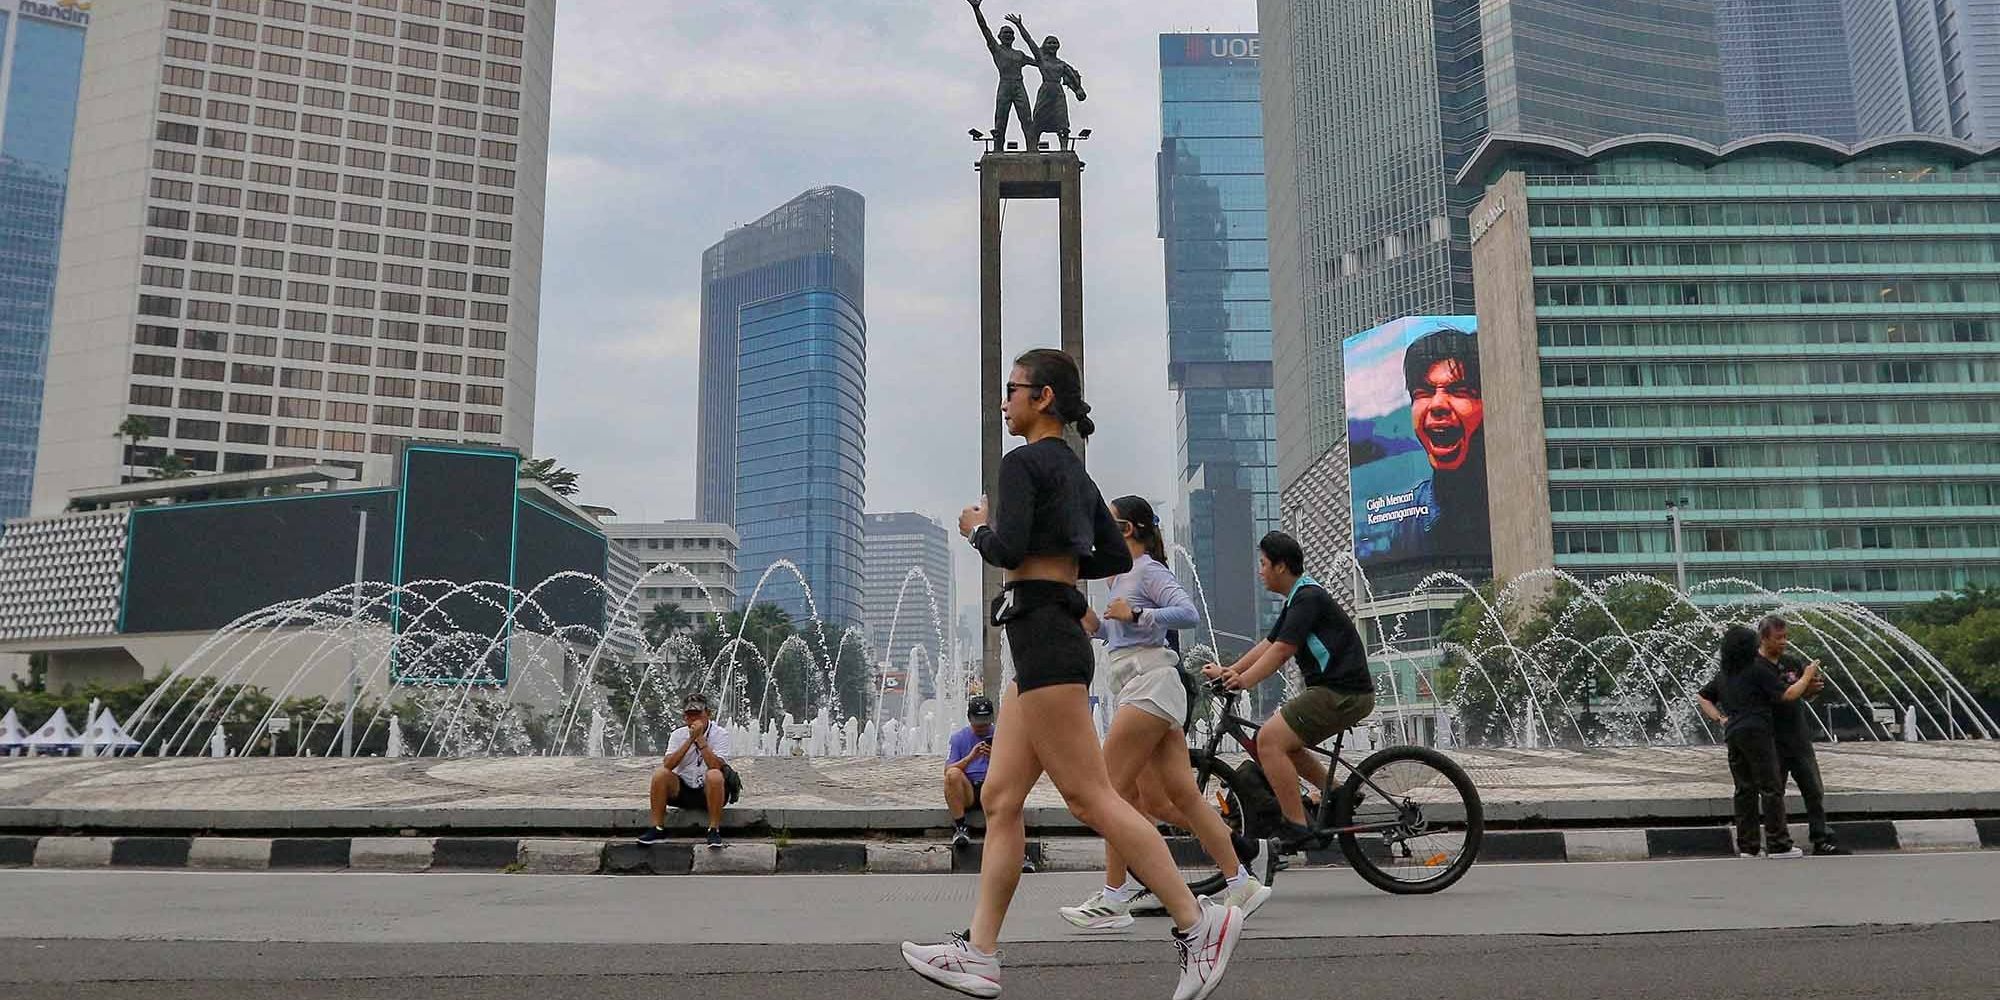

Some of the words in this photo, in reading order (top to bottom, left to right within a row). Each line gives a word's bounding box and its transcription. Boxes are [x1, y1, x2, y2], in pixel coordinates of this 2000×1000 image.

[1367, 497, 1385, 512] Gigih
[1386, 490, 1414, 506] Mencari
[1368, 506, 1429, 524] Kemenangannya
